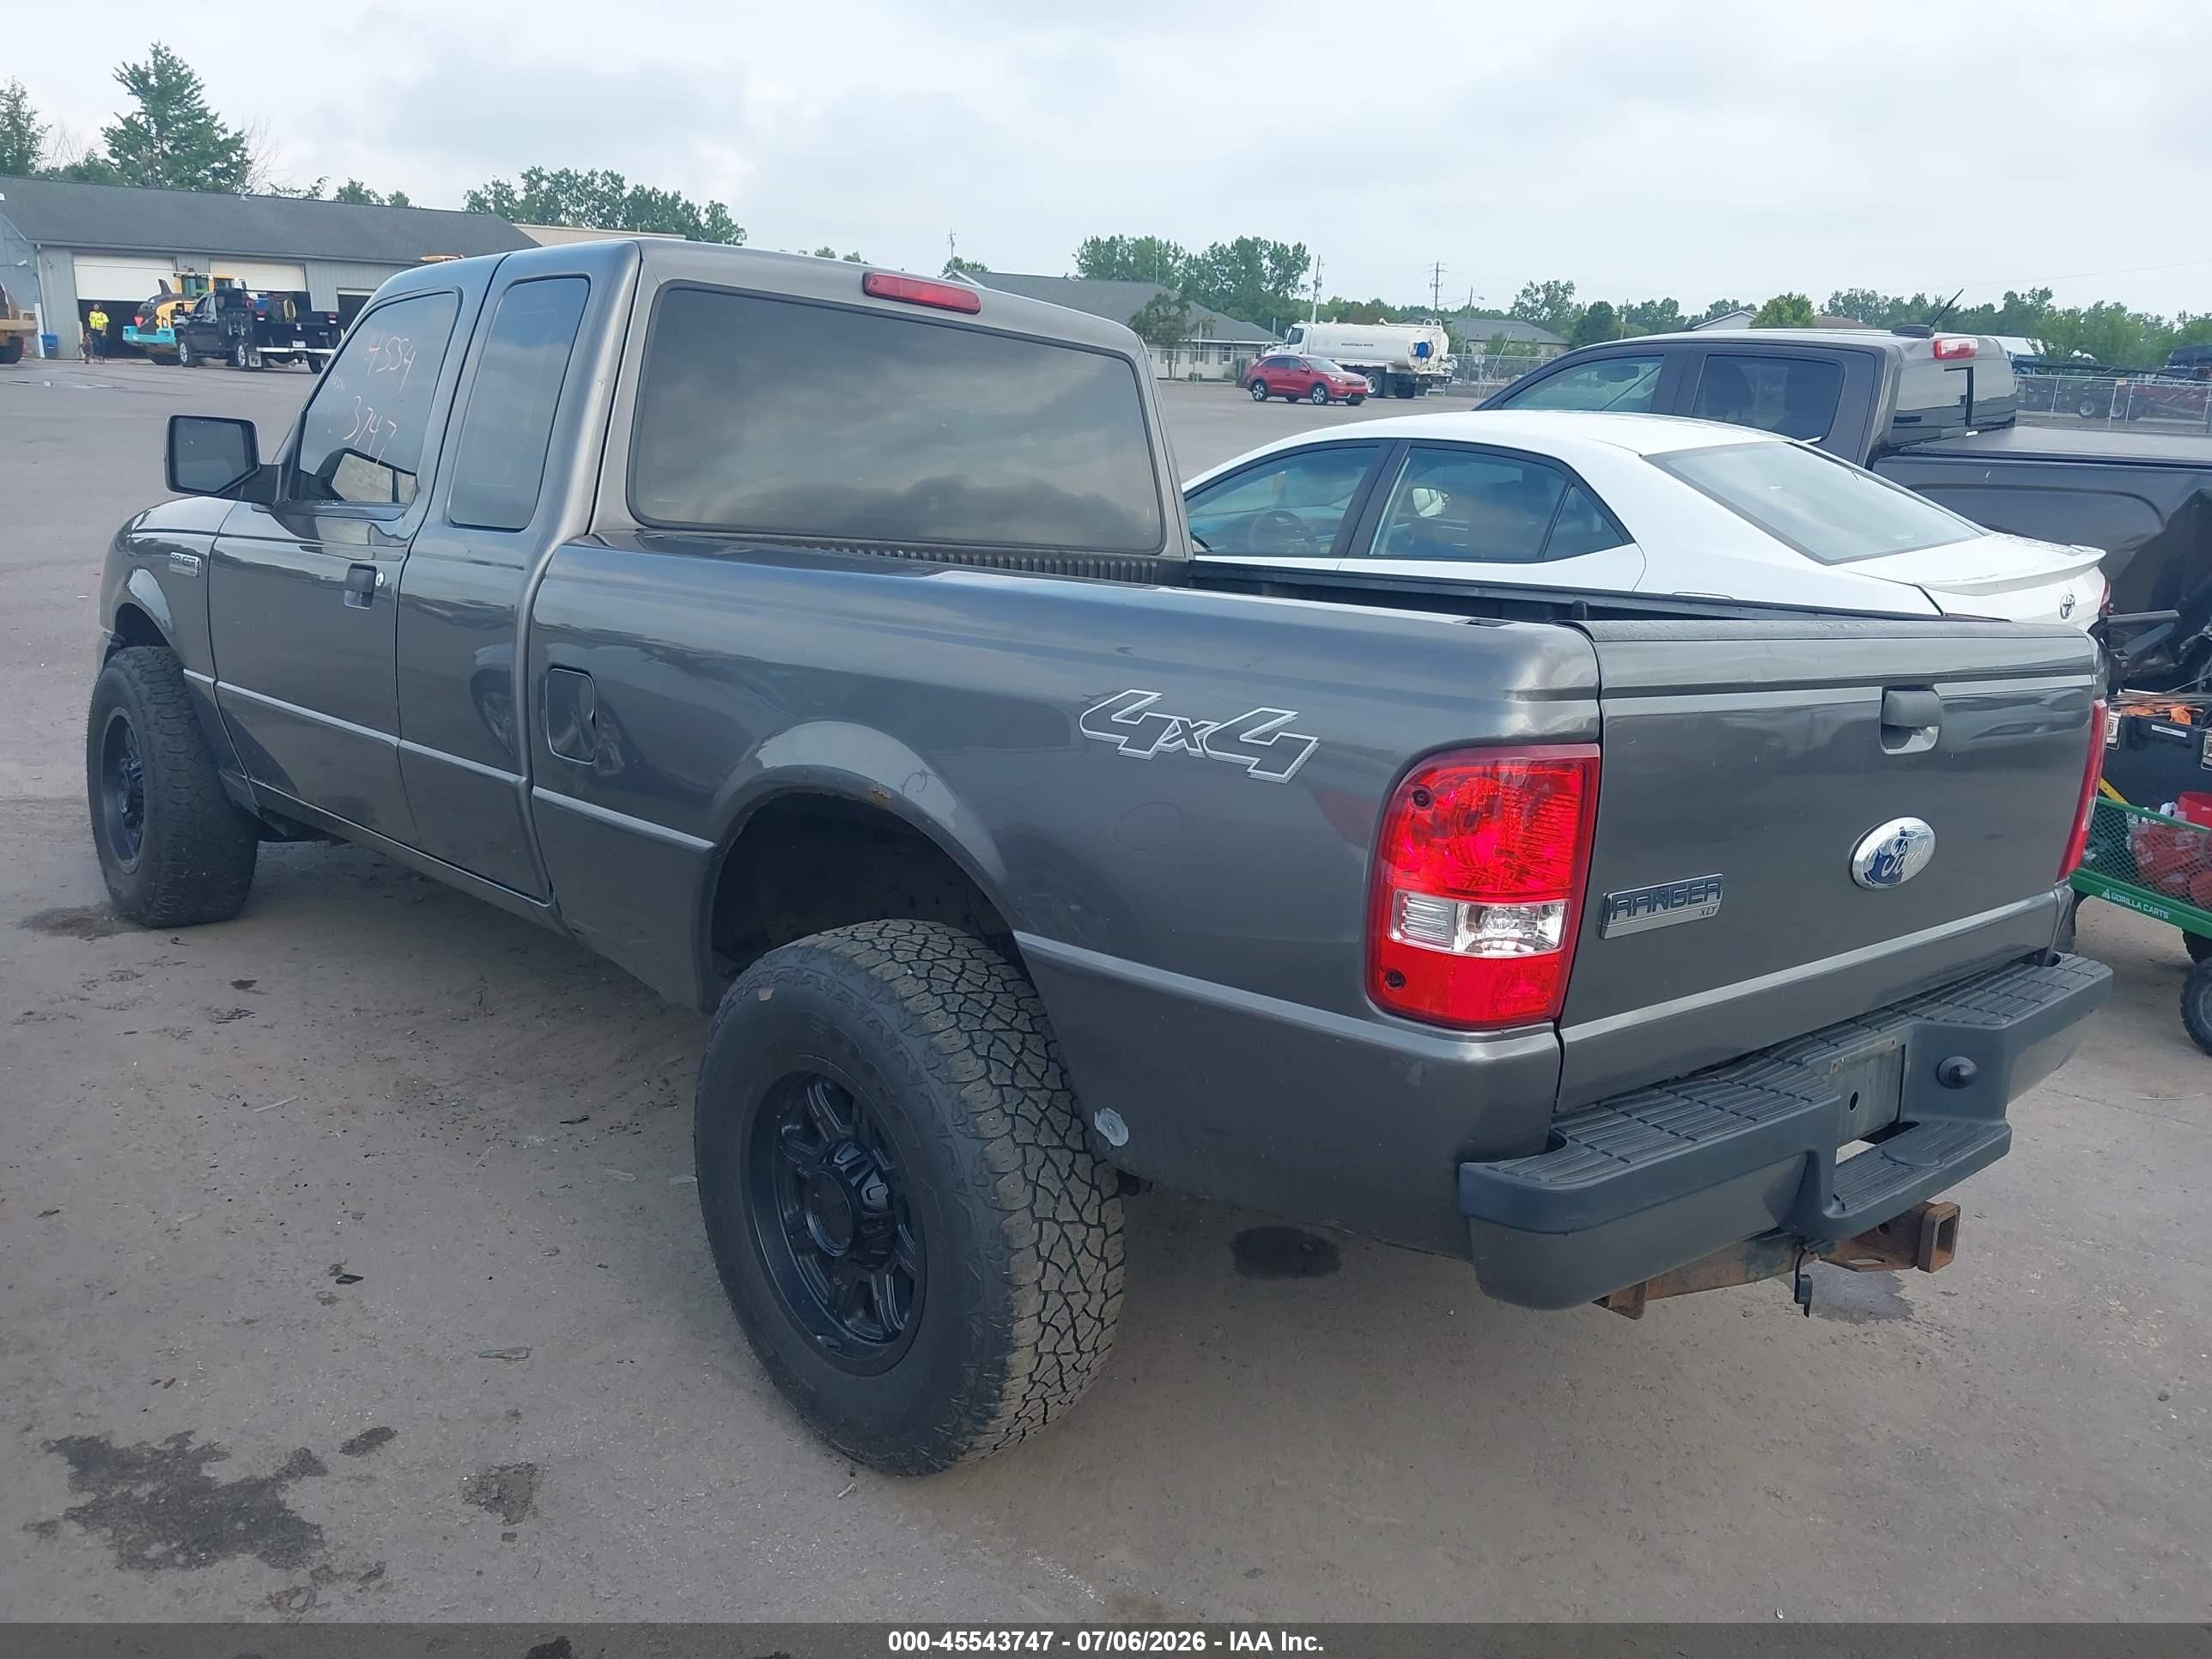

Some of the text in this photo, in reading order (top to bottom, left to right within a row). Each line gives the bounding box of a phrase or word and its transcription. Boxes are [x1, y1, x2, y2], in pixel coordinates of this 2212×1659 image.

[1611, 878, 1723, 921] RANGER
[1699, 907, 1717, 917] XLT
[2111, 893, 2170, 919] GORILLA CARTS
